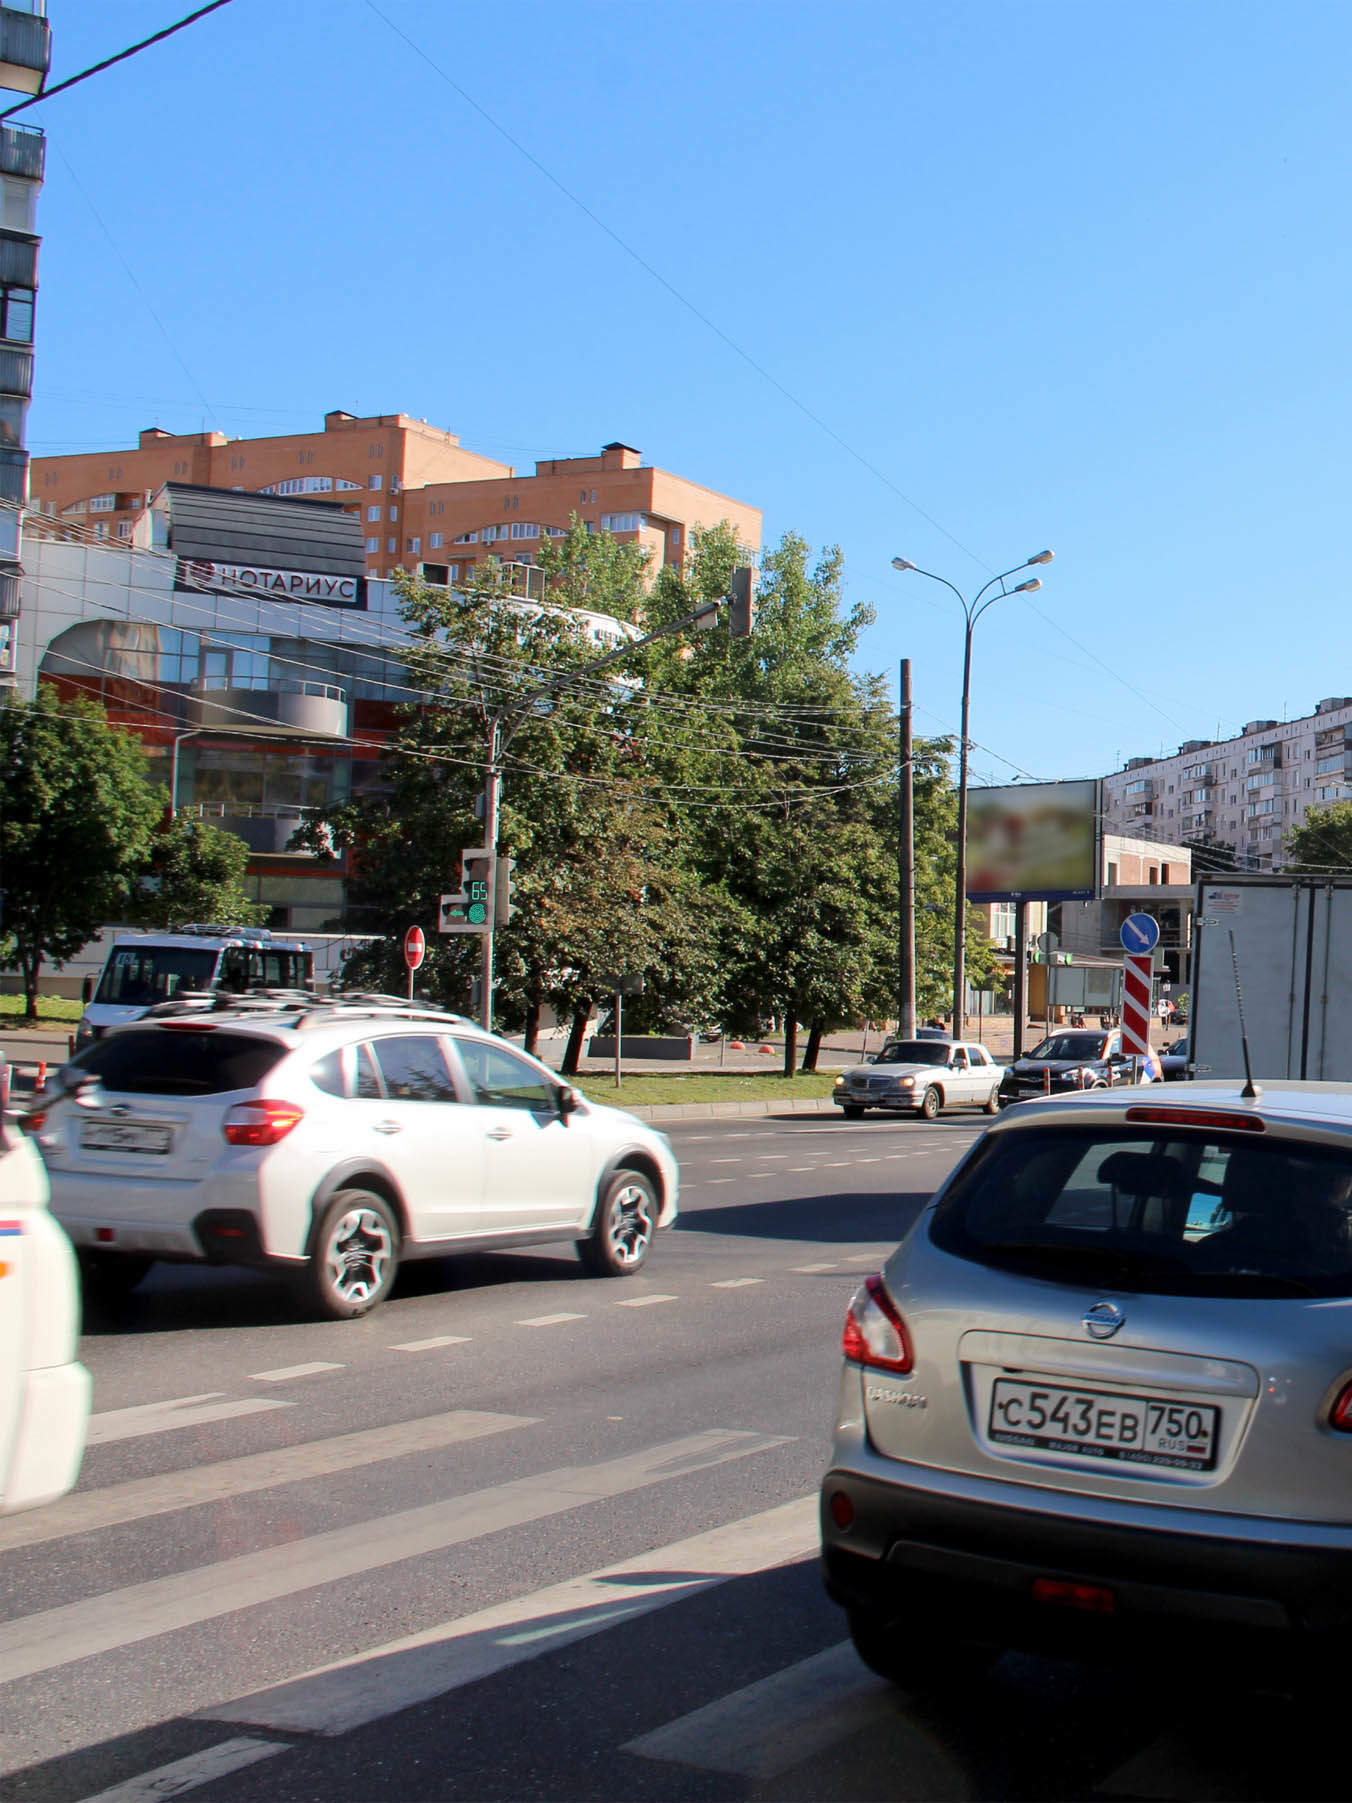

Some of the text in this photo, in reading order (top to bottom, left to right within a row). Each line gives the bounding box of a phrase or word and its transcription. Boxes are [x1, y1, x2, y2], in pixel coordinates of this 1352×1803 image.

[221, 567, 355, 599] НОТАРИУС
[471, 881, 488, 901] 65
[1157, 1438, 1186, 1451] RUS
